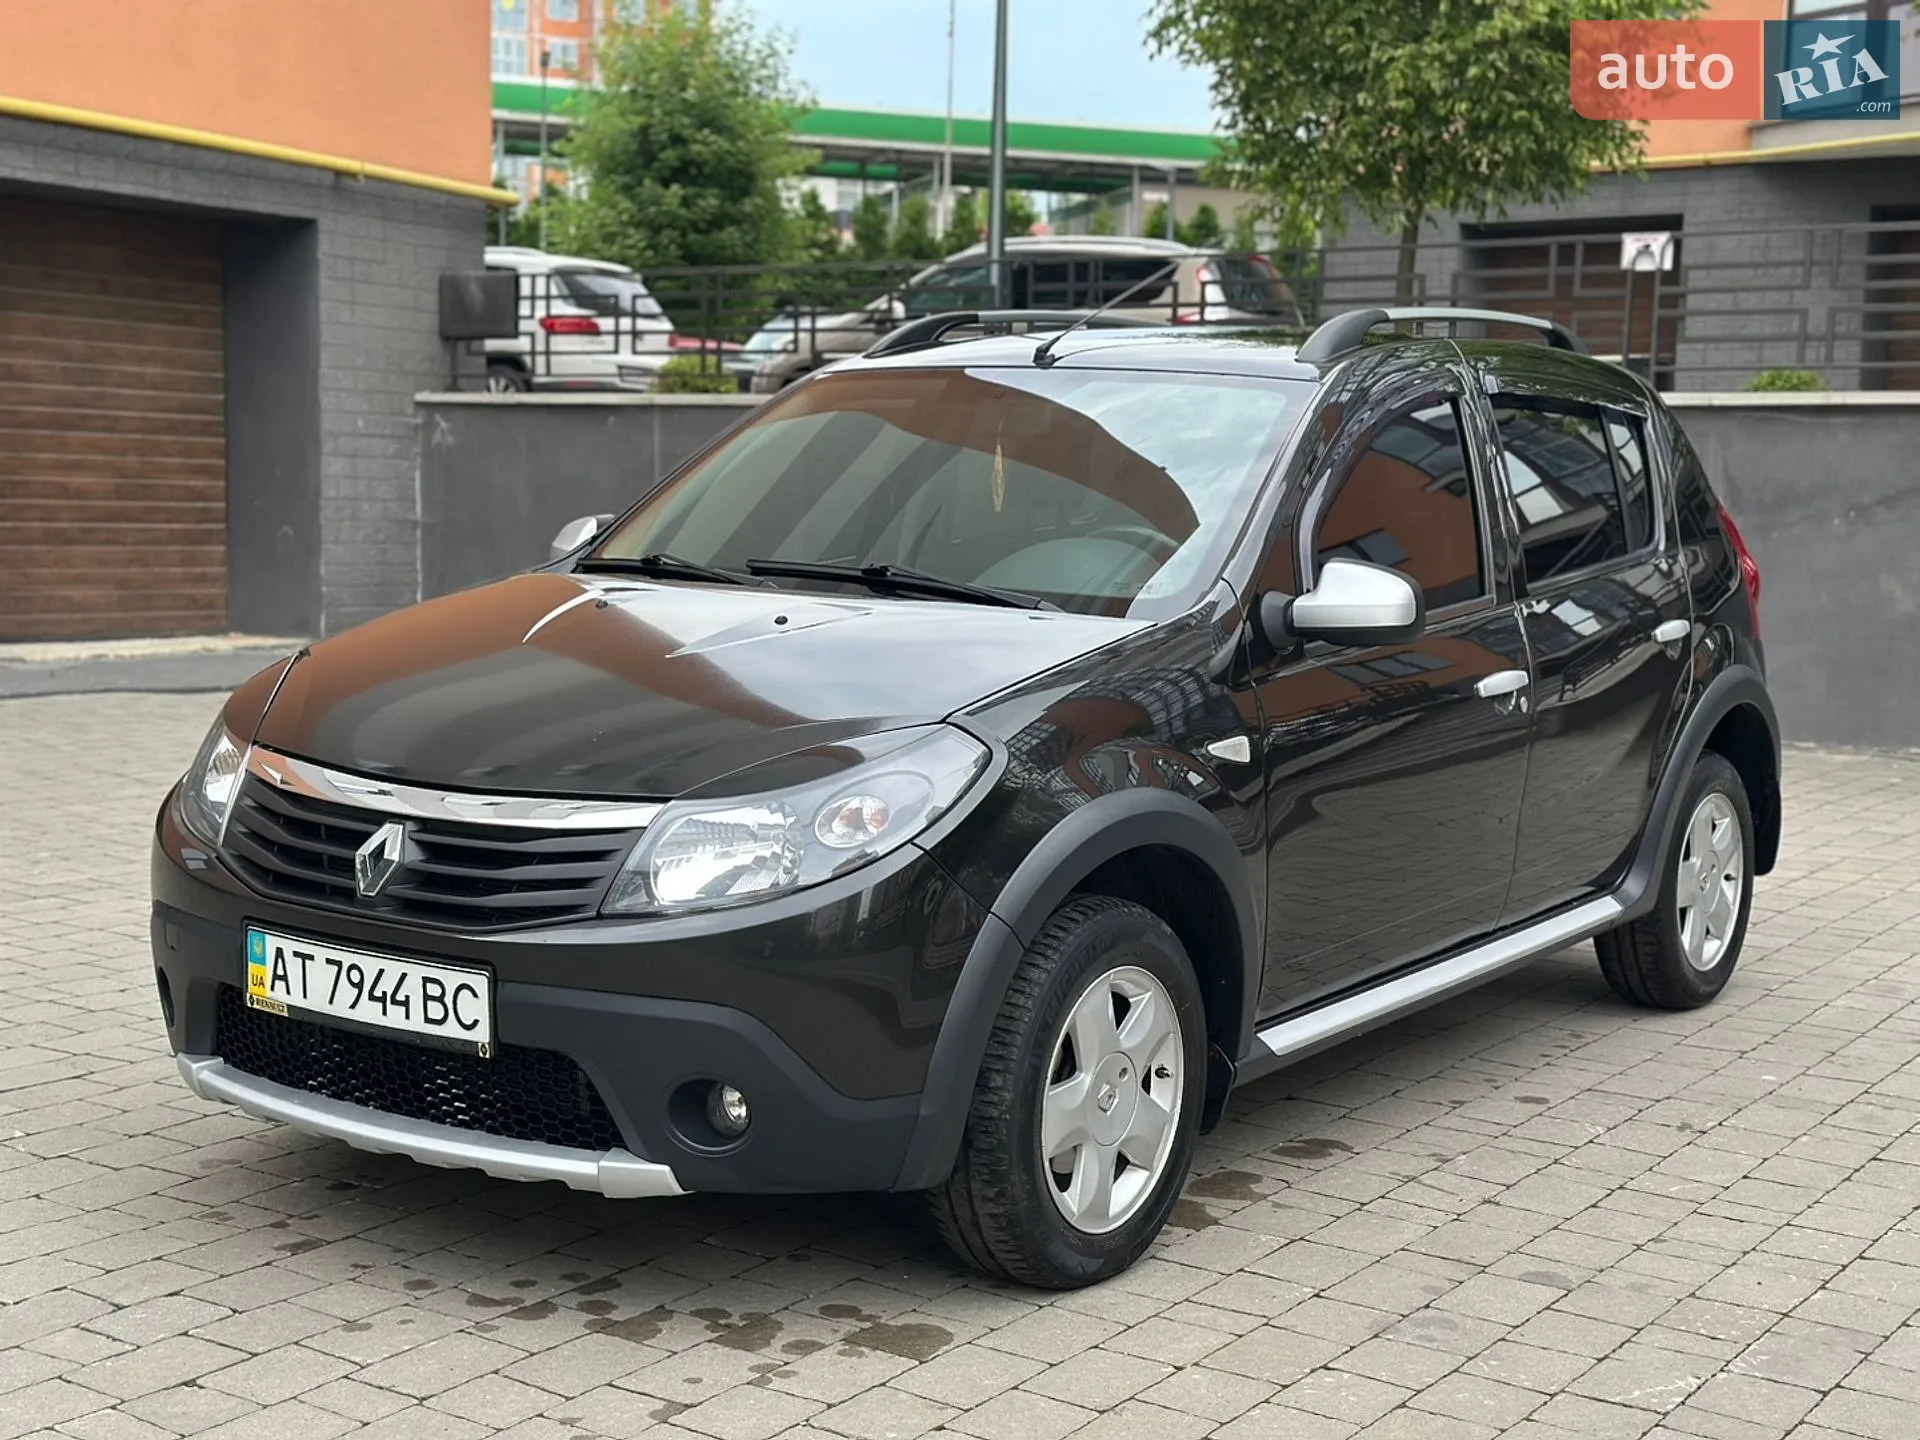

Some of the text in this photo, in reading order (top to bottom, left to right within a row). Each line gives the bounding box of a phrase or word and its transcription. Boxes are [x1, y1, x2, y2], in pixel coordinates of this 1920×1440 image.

[251, 972, 266, 989] UA
[270, 946, 480, 1031] AT 7944 BC
